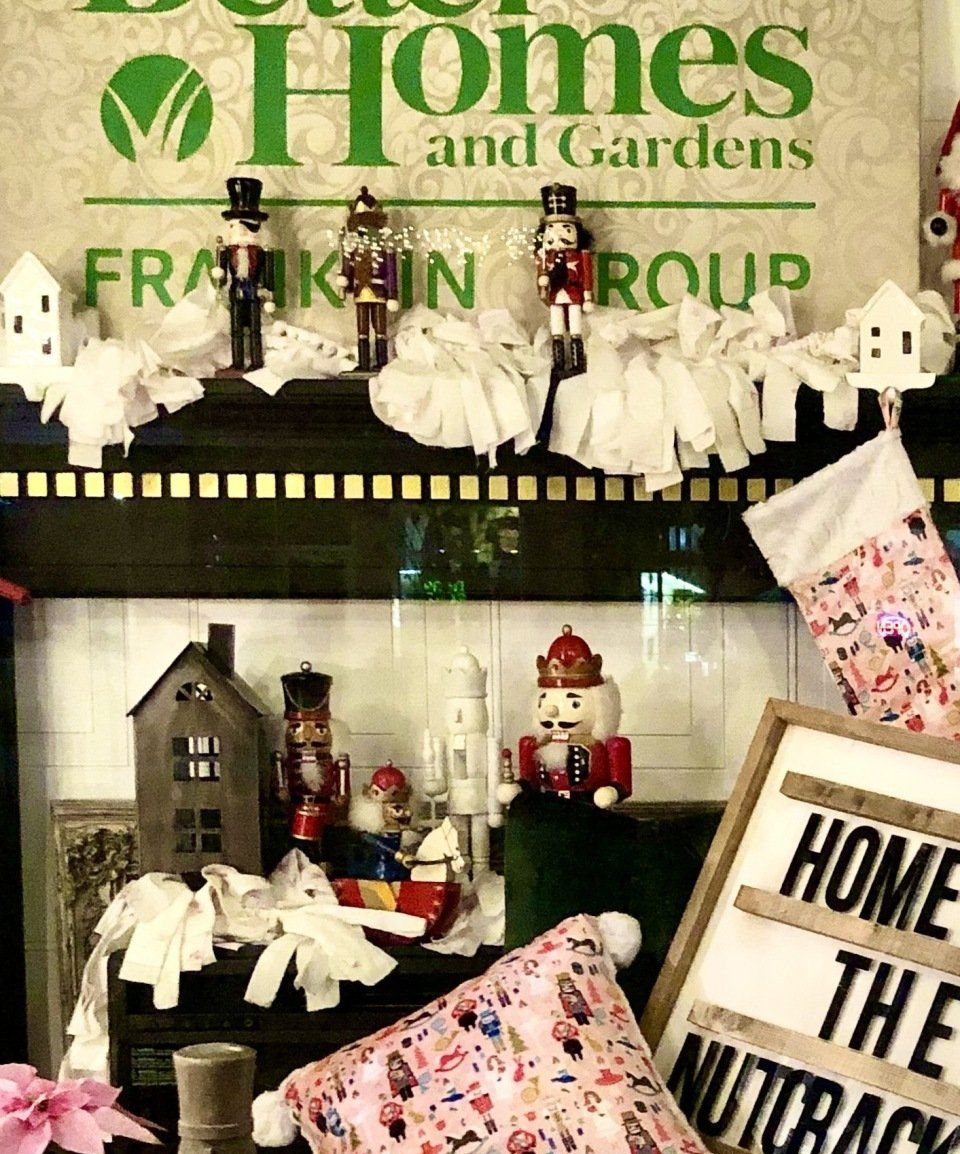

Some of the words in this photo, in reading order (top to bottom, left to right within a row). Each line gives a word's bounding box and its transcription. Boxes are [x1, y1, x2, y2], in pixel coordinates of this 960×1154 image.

[234, 23, 815, 168] Homes
[427, 123, 537, 169] and
[559, 123, 815, 171] Gardens
[84, 247, 475, 310] FRAKIN
[596, 250, 811, 311] ROUP
